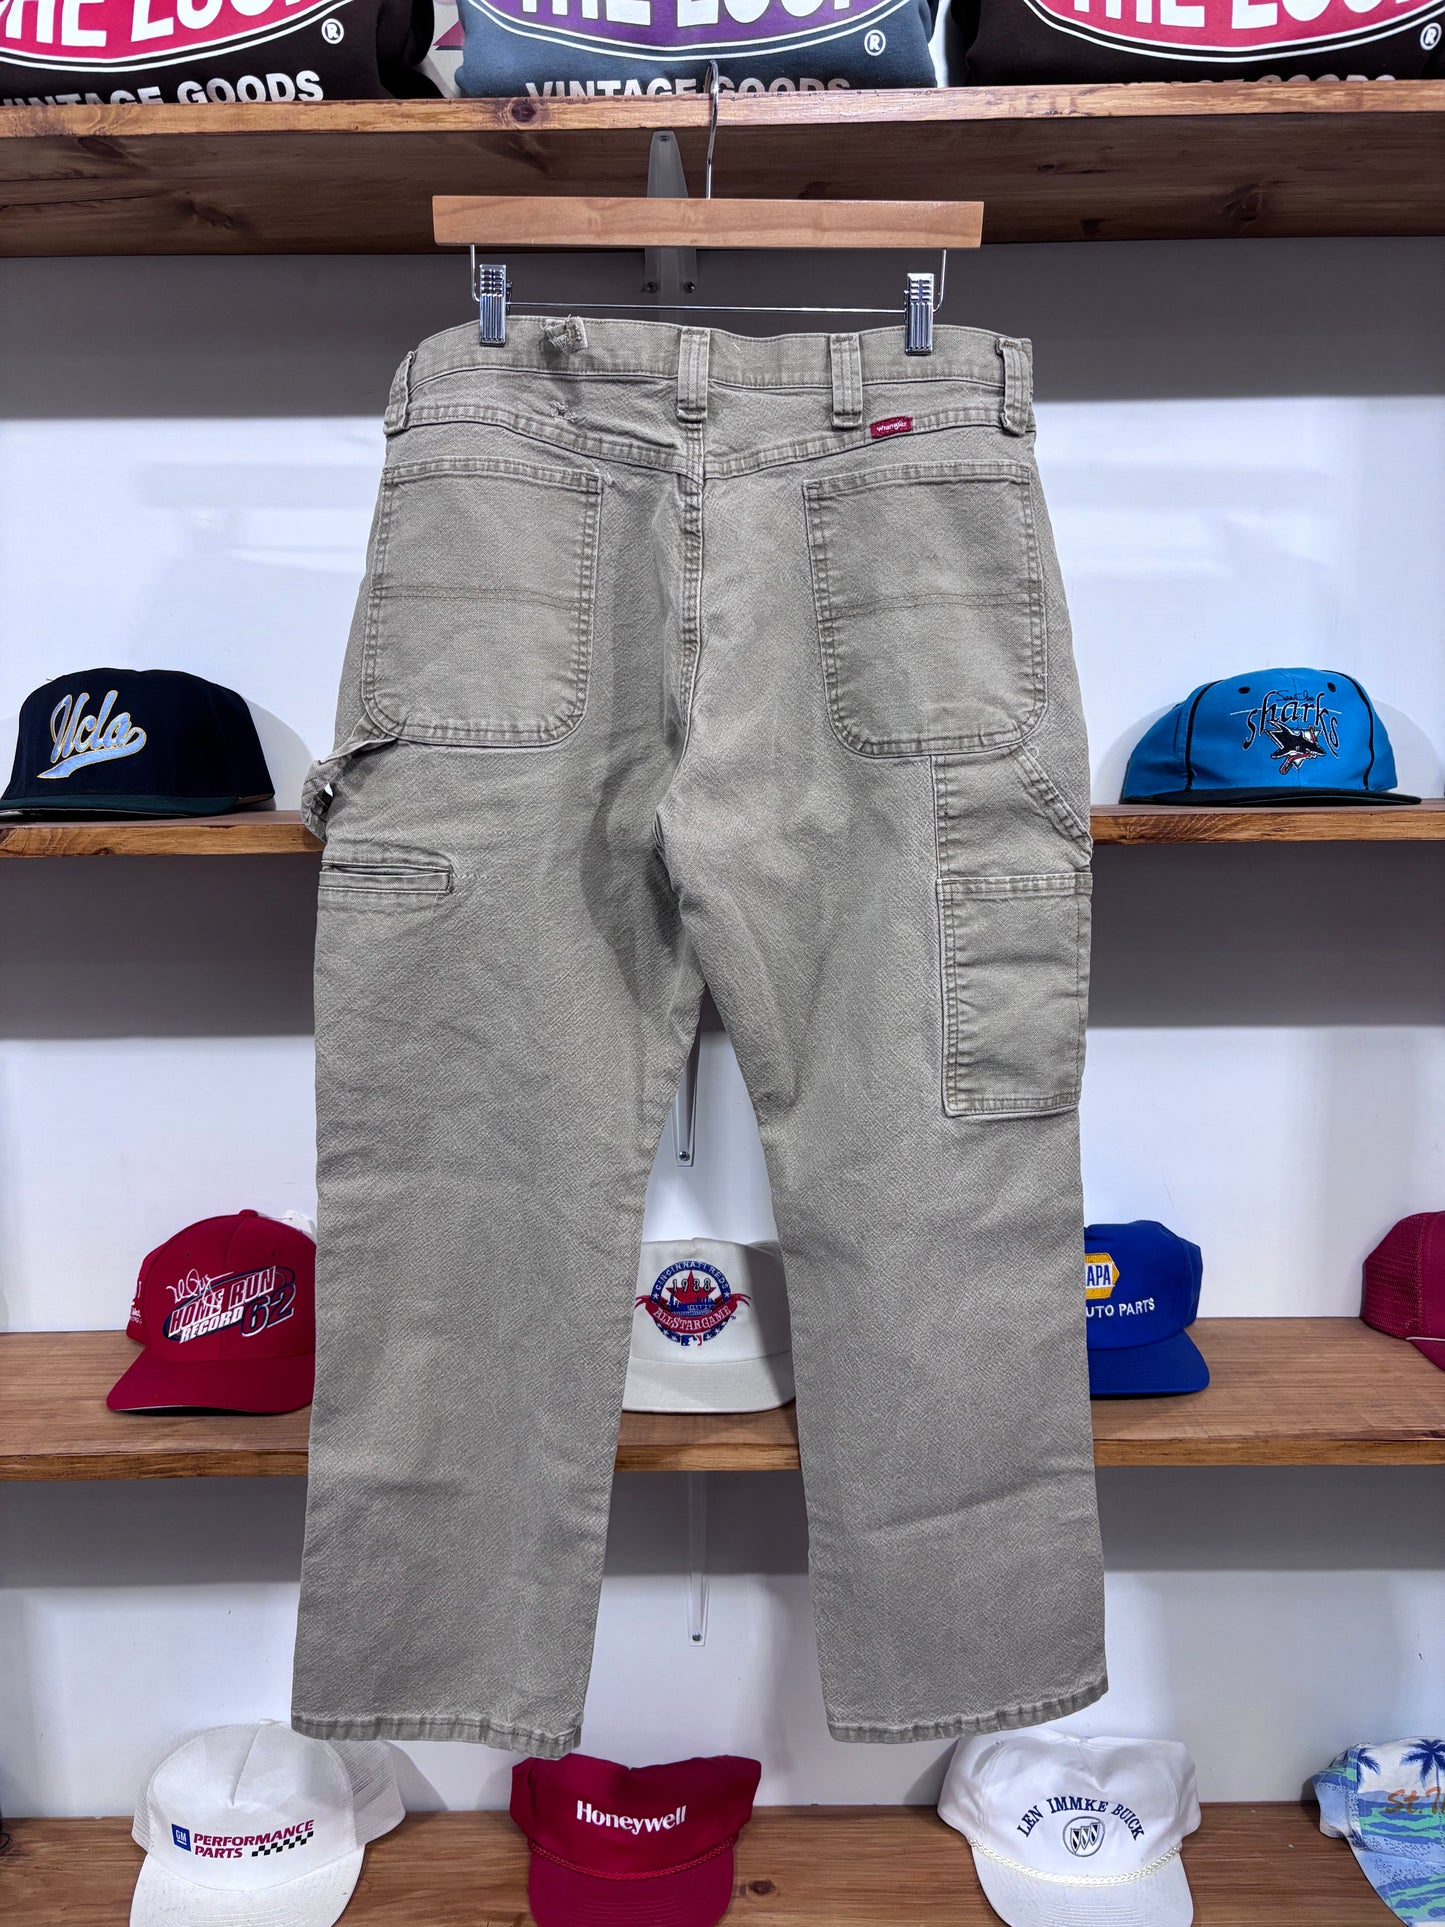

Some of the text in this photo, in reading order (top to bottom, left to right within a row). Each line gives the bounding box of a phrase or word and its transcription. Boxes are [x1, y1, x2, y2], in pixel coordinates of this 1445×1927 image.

[177, 70, 324, 104] GOODS
[876, 420, 907, 432] Wrangler
[655, 1260, 729, 1290] CINCINNATI REDS
[672, 1277, 712, 1293] 1988
[1087, 1264, 1111, 1287] APA
[168, 1288, 225, 1338] HOME
[228, 1265, 276, 1310] RUN
[241, 1282, 296, 1337] 62
[1086, 1297, 1155, 1318] UTO PARTS
[179, 1305, 244, 1345] RECORD
[576, 1799, 687, 1836] Honeywell
[1016, 1795, 1145, 1841] LEN IMMKE BUICK
[175, 1829, 187, 1843] GM
[193, 1819, 315, 1847] PERFORMANCE
[194, 1845, 243, 1858] PARTS
